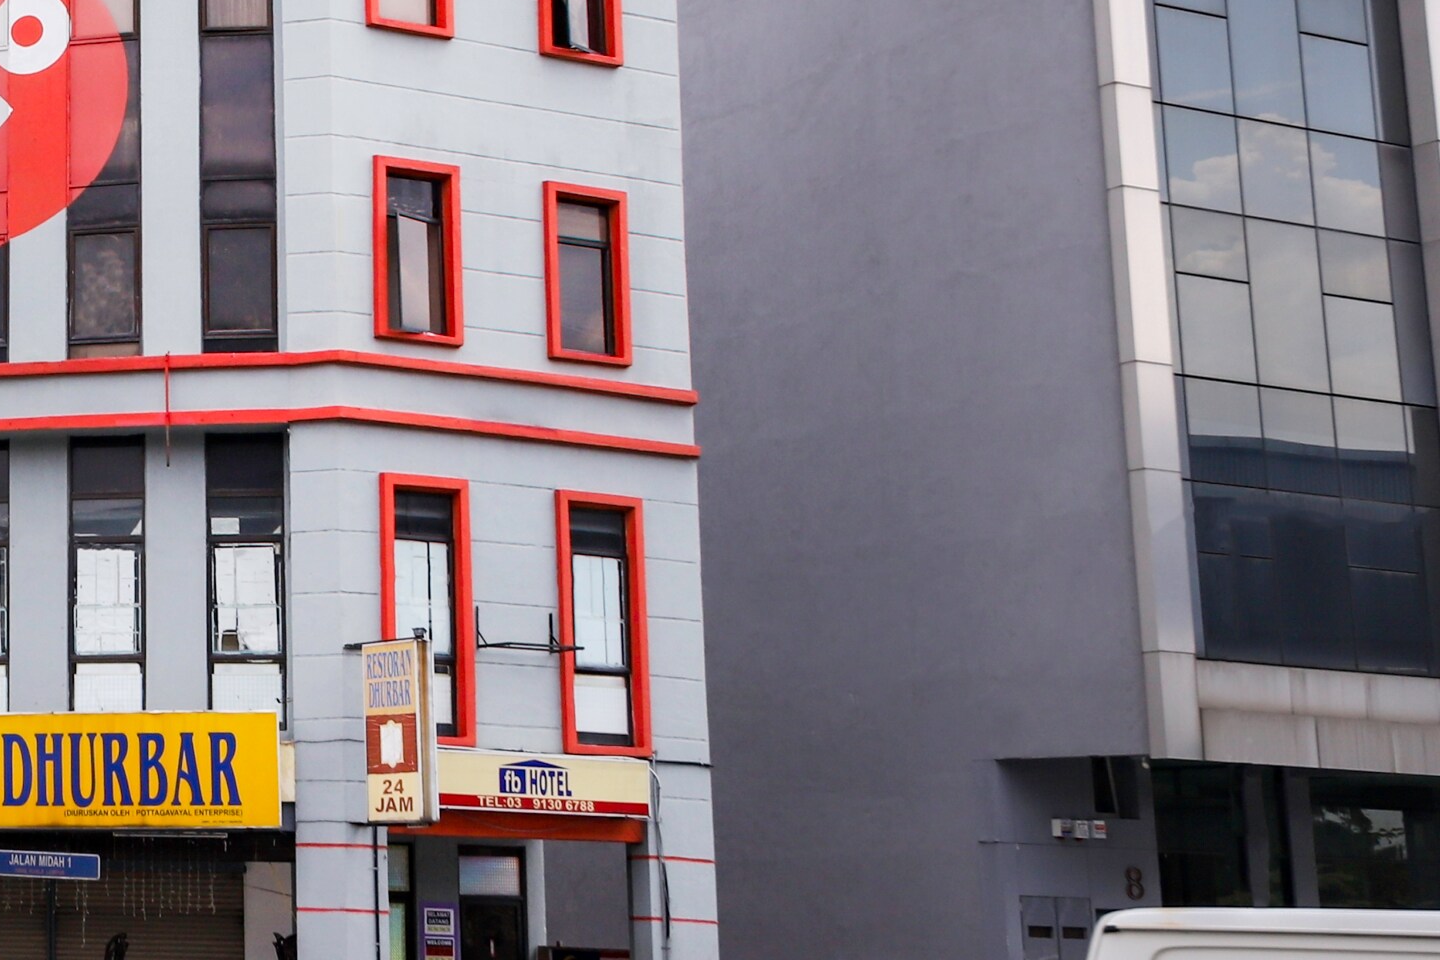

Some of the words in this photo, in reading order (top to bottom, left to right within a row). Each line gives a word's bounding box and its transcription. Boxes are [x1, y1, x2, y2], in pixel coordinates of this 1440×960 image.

[366, 649, 412, 680] RESTORAN
[368, 679, 411, 709] DHURBAR
[1, 732, 243, 808] DHURBAR
[383, 779, 405, 795] 24
[503, 770, 522, 793] fb
[529, 768, 573, 797] HOTEL
[110, 809, 130, 817] OLEH
[375, 797, 414, 814] JAM
[477, 795, 522, 809] TEL:03
[533, 798, 562, 811] 9130
[565, 800, 595, 813] 6788
[9, 854, 36, 867] JALAN
[39, 855, 65, 868] MIDAH
[67, 856, 72, 869] 1
[1126, 866, 1144, 901] 8
